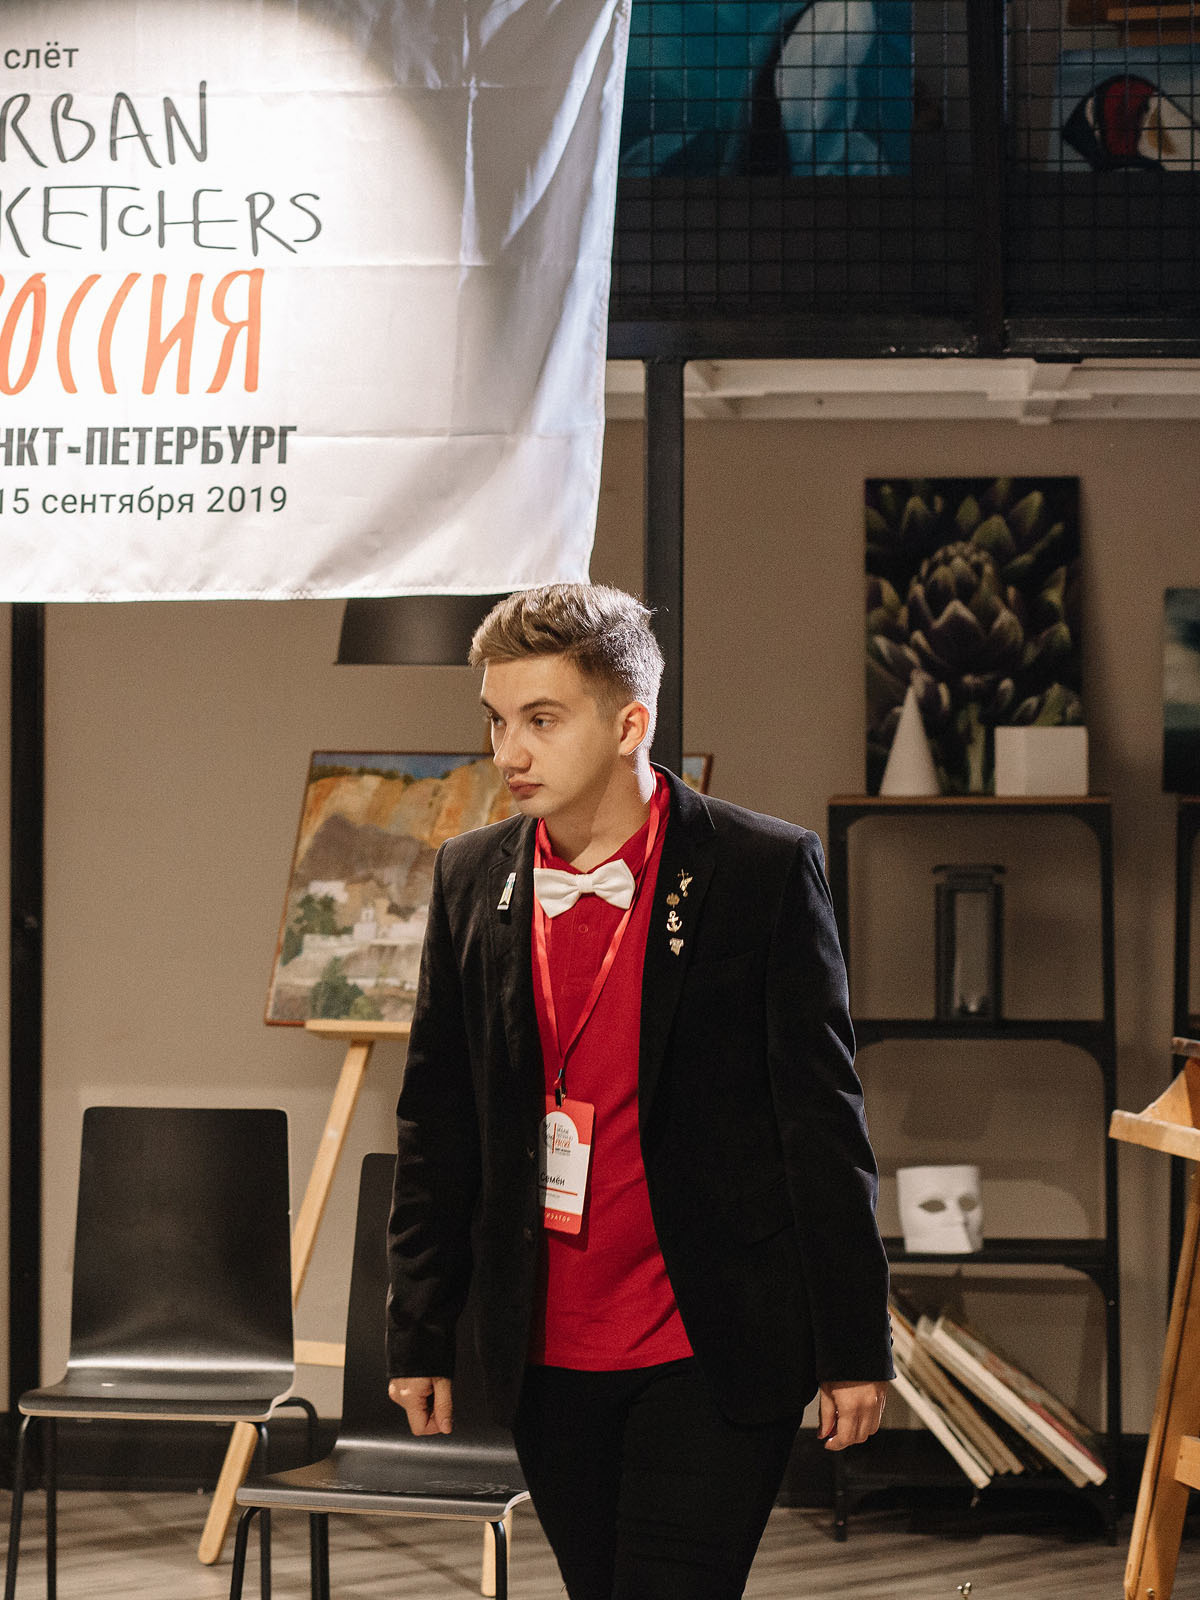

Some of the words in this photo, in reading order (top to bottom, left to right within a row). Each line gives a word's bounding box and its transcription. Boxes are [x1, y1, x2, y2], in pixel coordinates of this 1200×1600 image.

[3, 41, 79, 69] слёт
[41, 485, 194, 520] сентября
[206, 485, 288, 513] 2019
